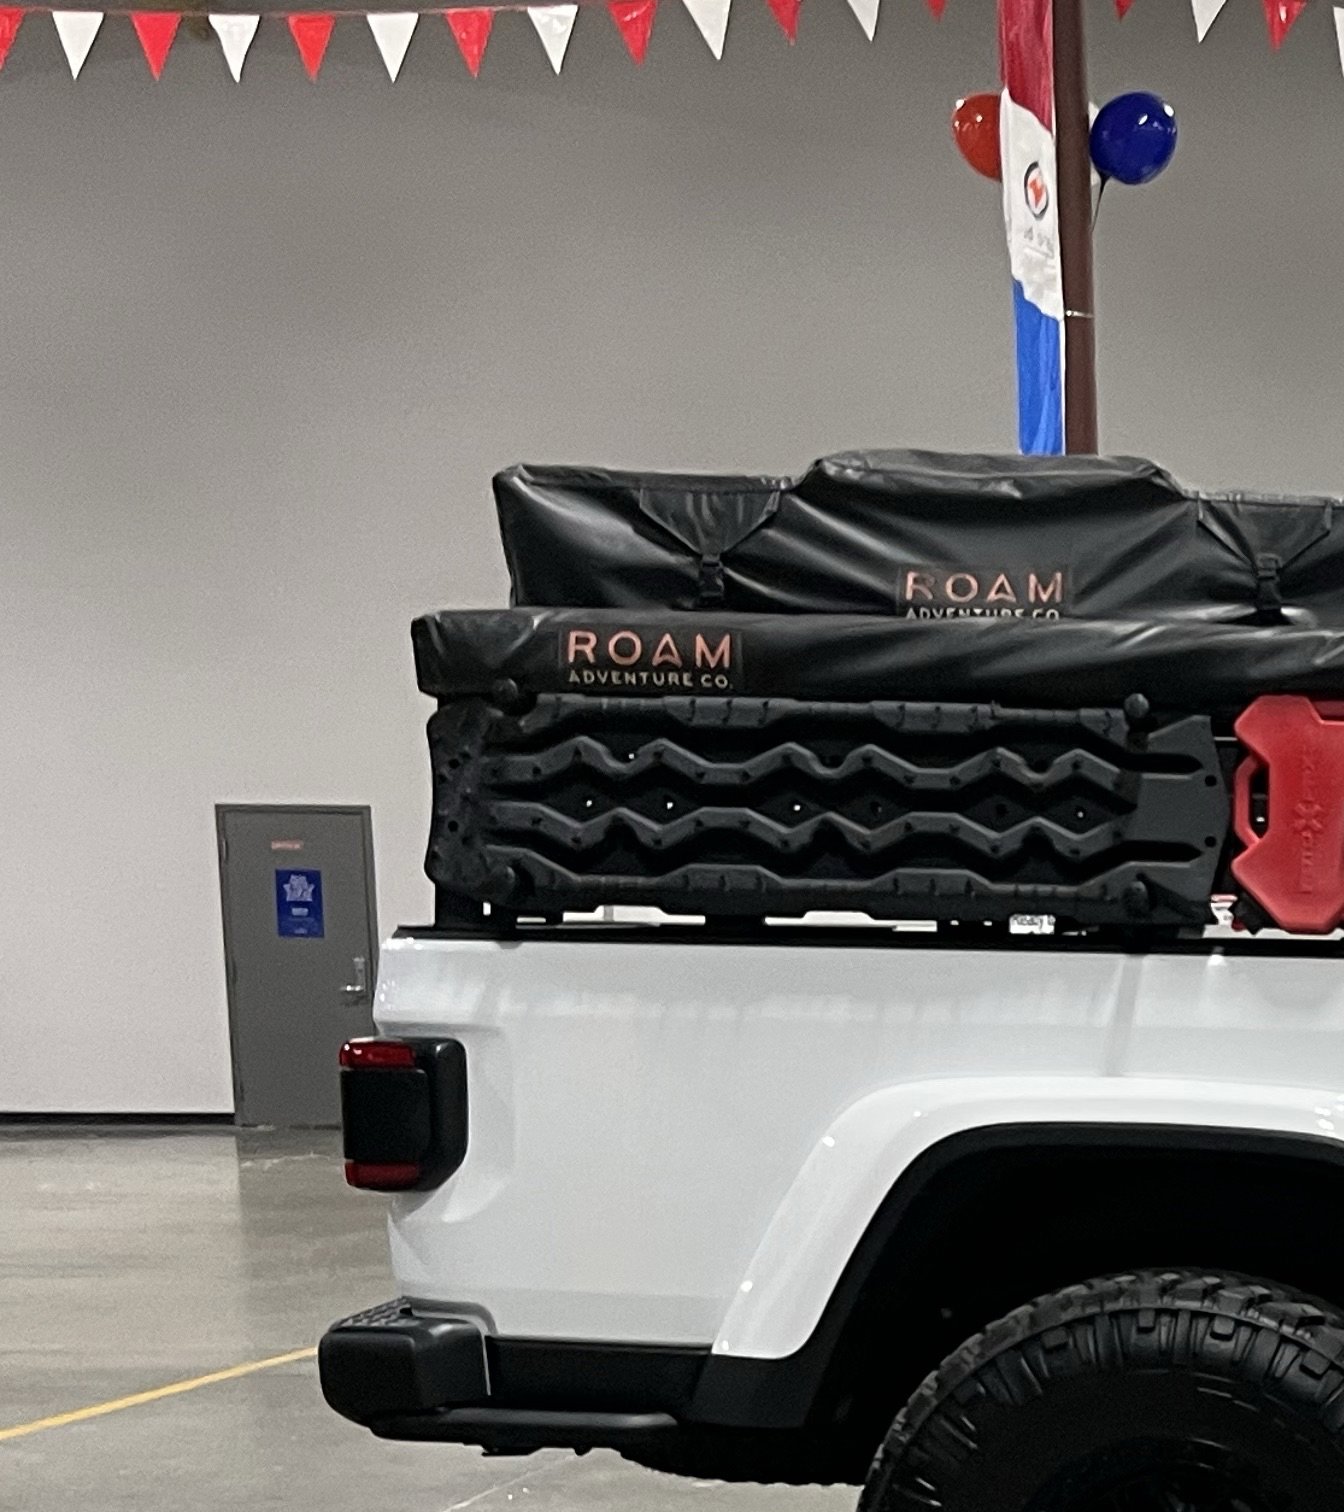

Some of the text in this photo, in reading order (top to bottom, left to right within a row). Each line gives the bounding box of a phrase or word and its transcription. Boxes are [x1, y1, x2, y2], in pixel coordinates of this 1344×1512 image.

[905, 570, 1063, 604] ROAM
[567, 629, 731, 669] ROAM
[568, 669, 694, 687] ADVENTURE
